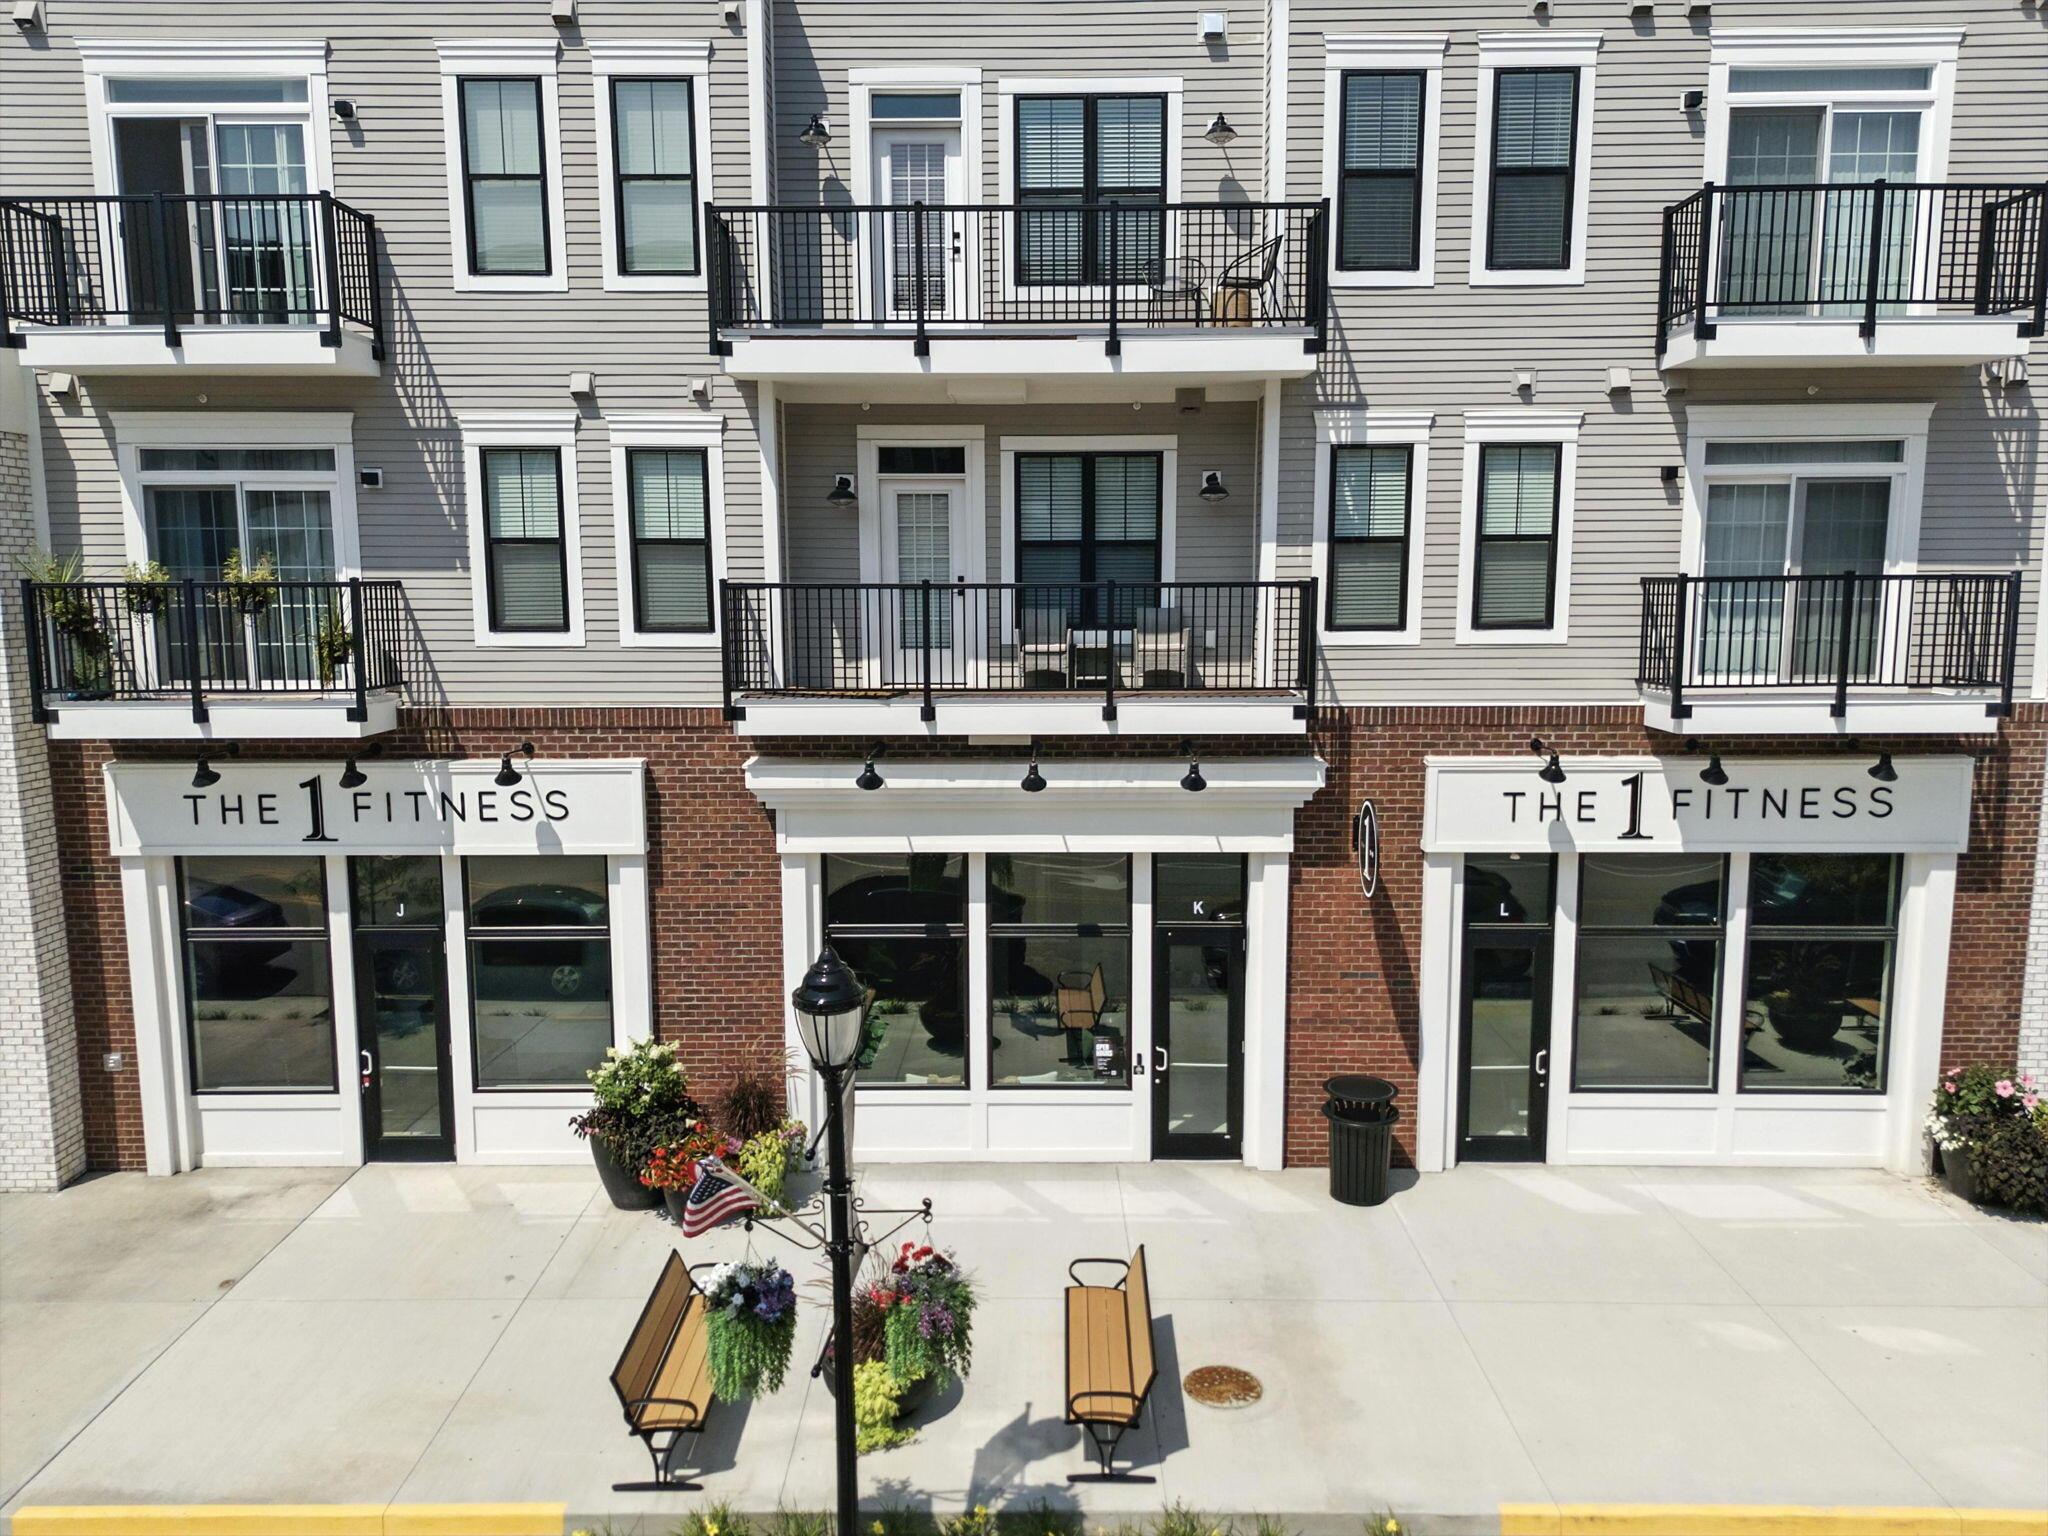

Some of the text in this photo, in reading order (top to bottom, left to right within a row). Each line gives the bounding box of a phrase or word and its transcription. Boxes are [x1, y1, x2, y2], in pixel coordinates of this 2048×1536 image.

[183, 774, 570, 842] THE 1 FITNESS
[1503, 771, 1894, 840] THE 1 FITNESS
[396, 903, 405, 917] J
[1193, 900, 1204, 915] K
[1500, 902, 1509, 916] L
